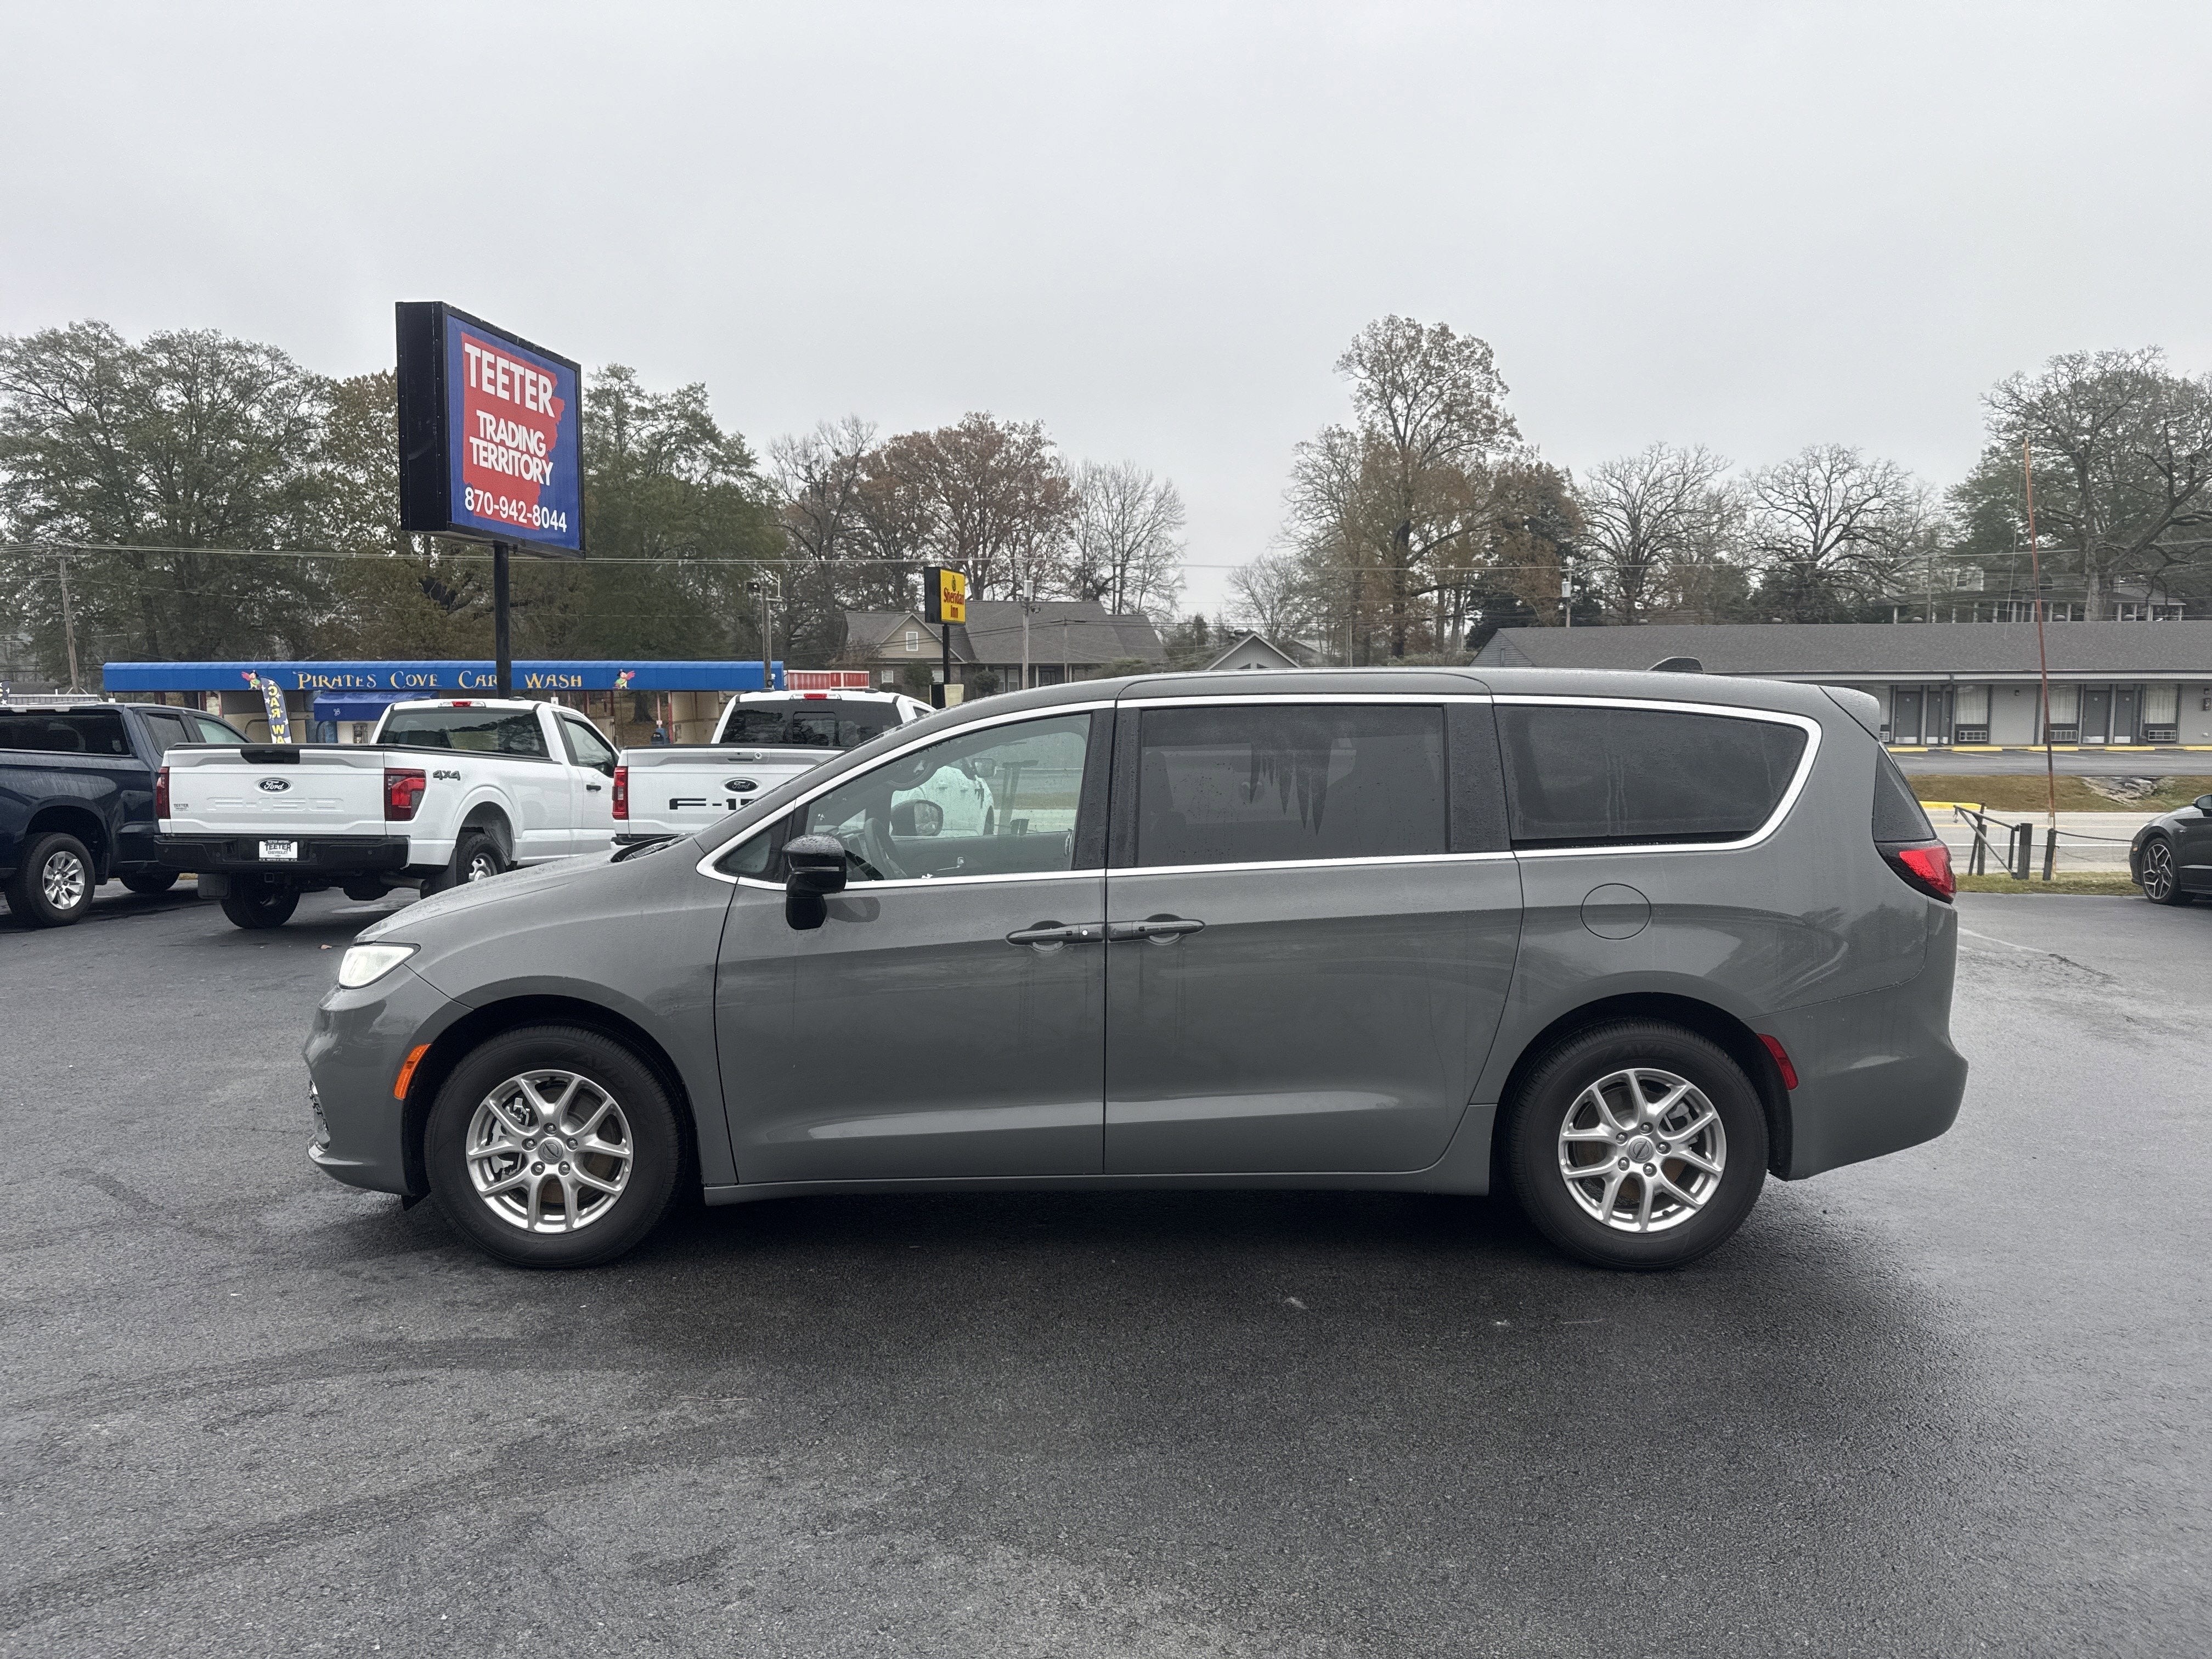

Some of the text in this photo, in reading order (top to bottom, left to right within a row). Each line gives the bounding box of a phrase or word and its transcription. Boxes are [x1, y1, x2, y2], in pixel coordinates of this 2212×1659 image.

[464, 342, 555, 418] TEETER
[476, 409, 547, 458] TRADING
[469, 436, 554, 486] TERRITORY
[464, 487, 567, 533] 870-942-8044
[944, 587, 964, 605] Sheridan
[292, 670, 583, 690] PIRATES COVE CAR WASH
[669, 798, 755, 810] F-1
[265, 844, 292, 852] TEETER
